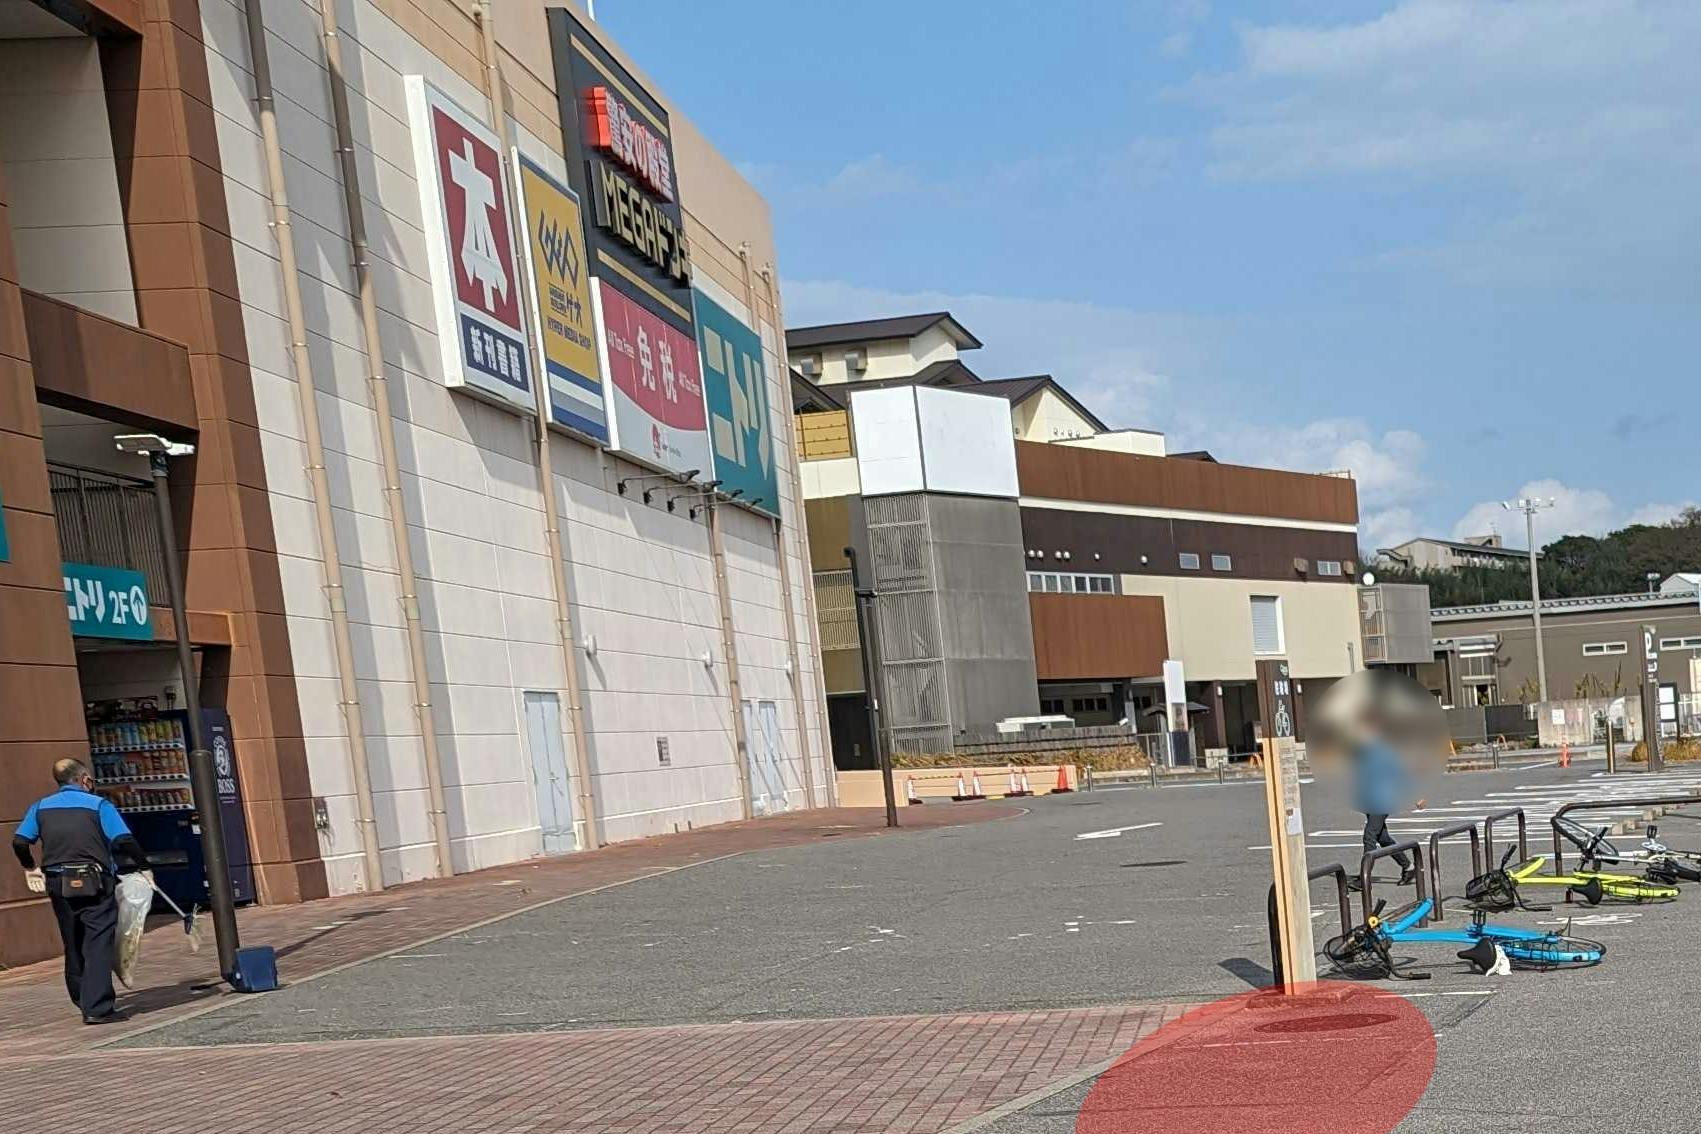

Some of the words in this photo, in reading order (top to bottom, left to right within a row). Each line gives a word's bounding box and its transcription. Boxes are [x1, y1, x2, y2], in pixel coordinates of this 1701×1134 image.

[448, 137, 508, 313] 本
[470, 326, 522, 384] 新刊書籍
[637, 325, 678, 404] 免税
[703, 325, 770, 481] ニトリ
[63, 576, 106, 623] ニトリ
[109, 590, 129, 625] 2F
[217, 778, 236, 794] BOSS
